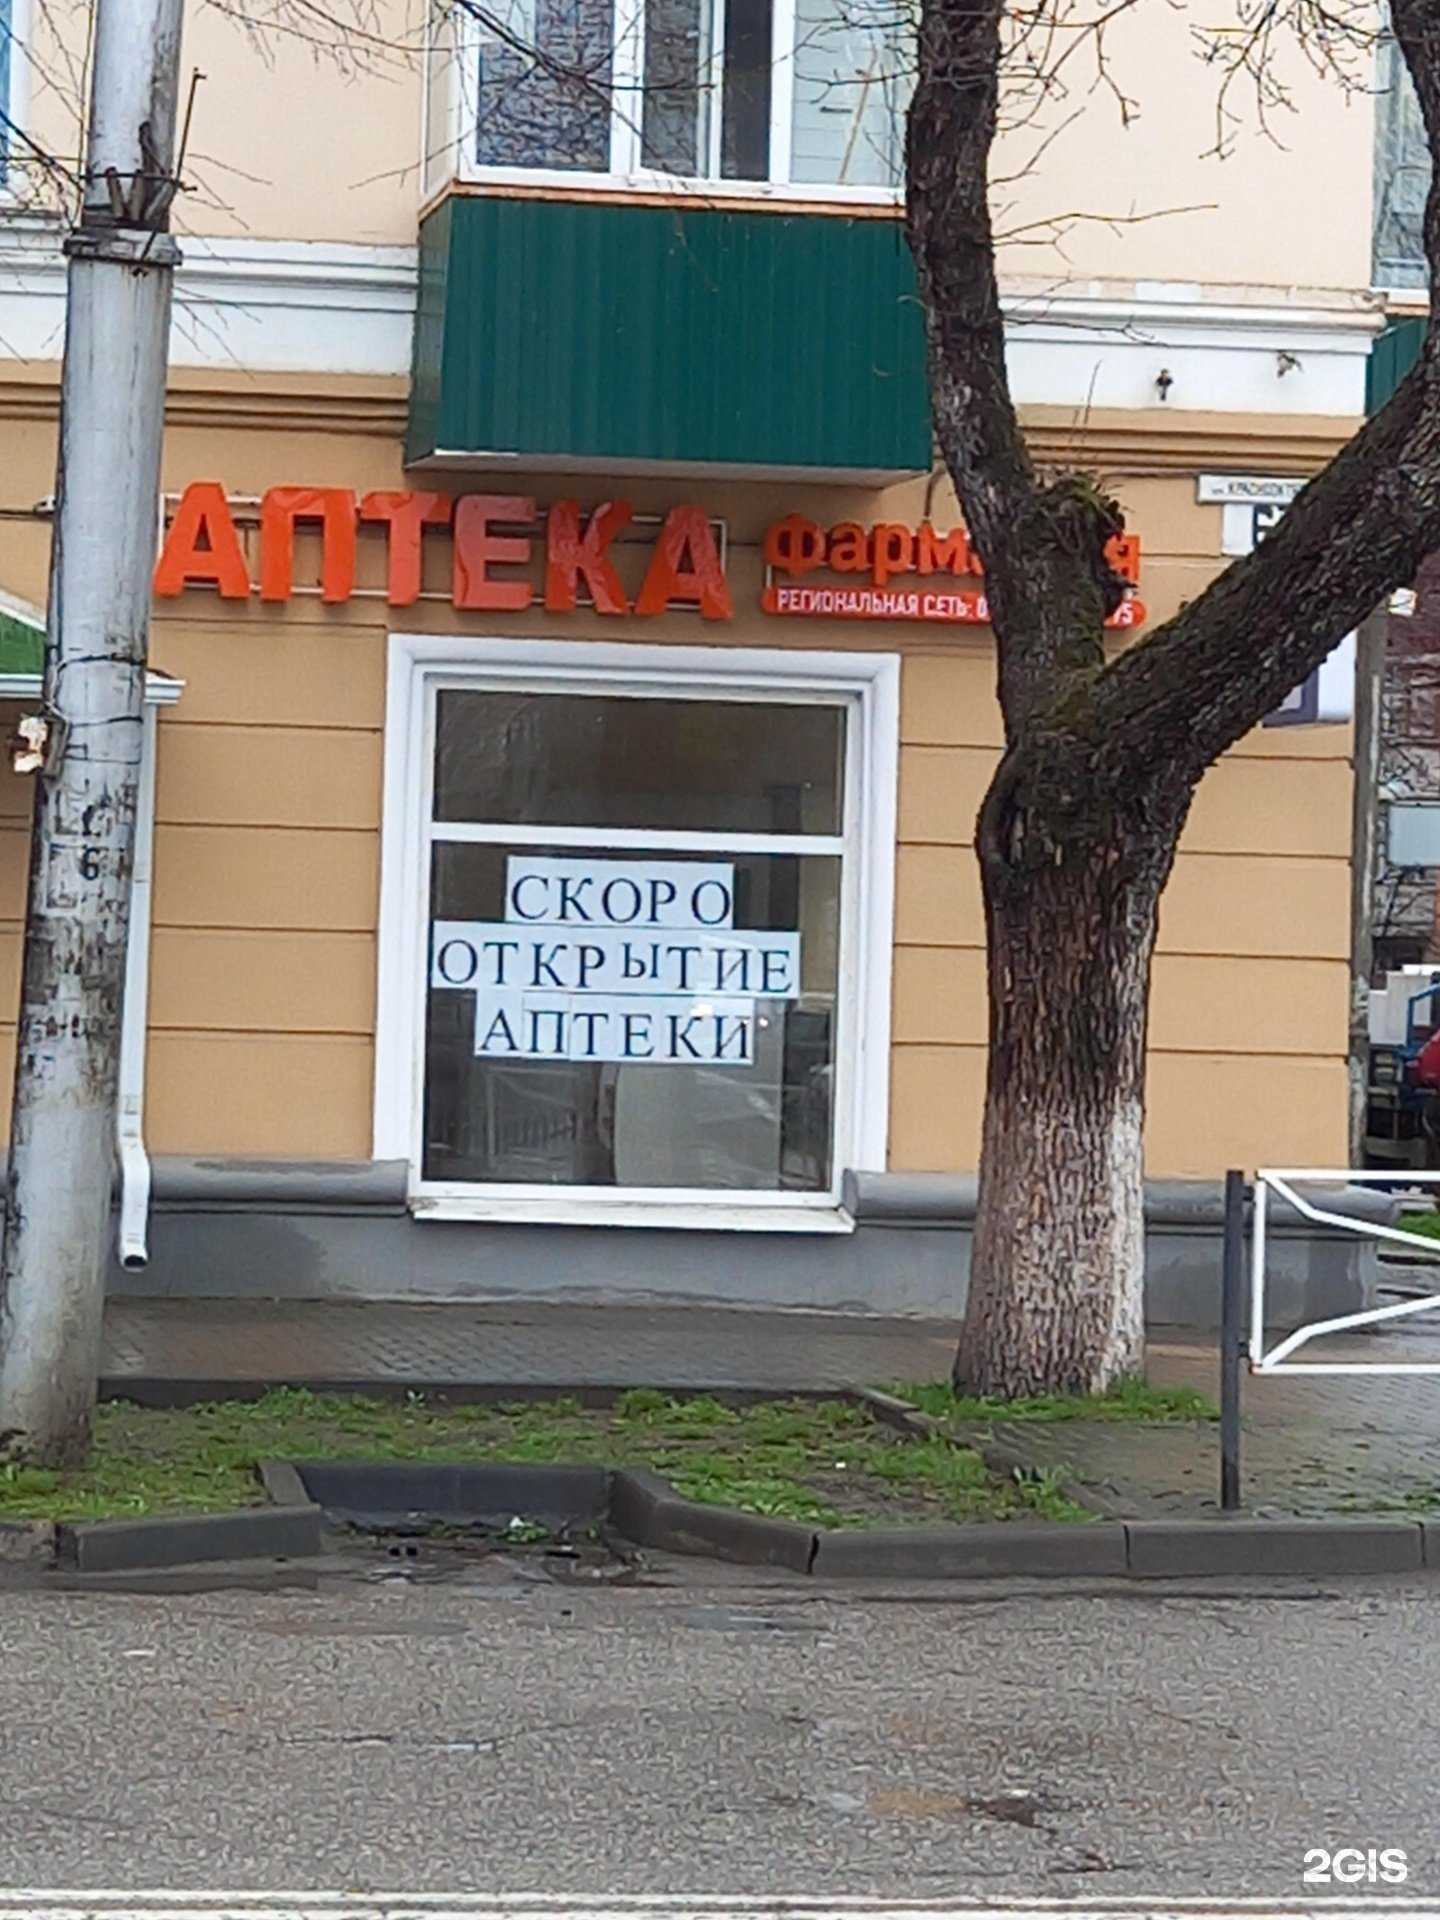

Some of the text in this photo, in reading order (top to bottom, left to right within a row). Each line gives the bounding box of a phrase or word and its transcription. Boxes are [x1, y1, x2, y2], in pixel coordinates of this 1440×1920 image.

[153, 482, 733, 621] АПТЕКА
[765, 513, 1140, 586] Фармя
[777, 588, 919, 616] РЕГИОНАЛЬНАЯ
[511, 874, 732, 924] СКОРО
[437, 940, 793, 994] ОТКРЫТИЕ
[478, 1008, 752, 1060] АПТЕКИ
